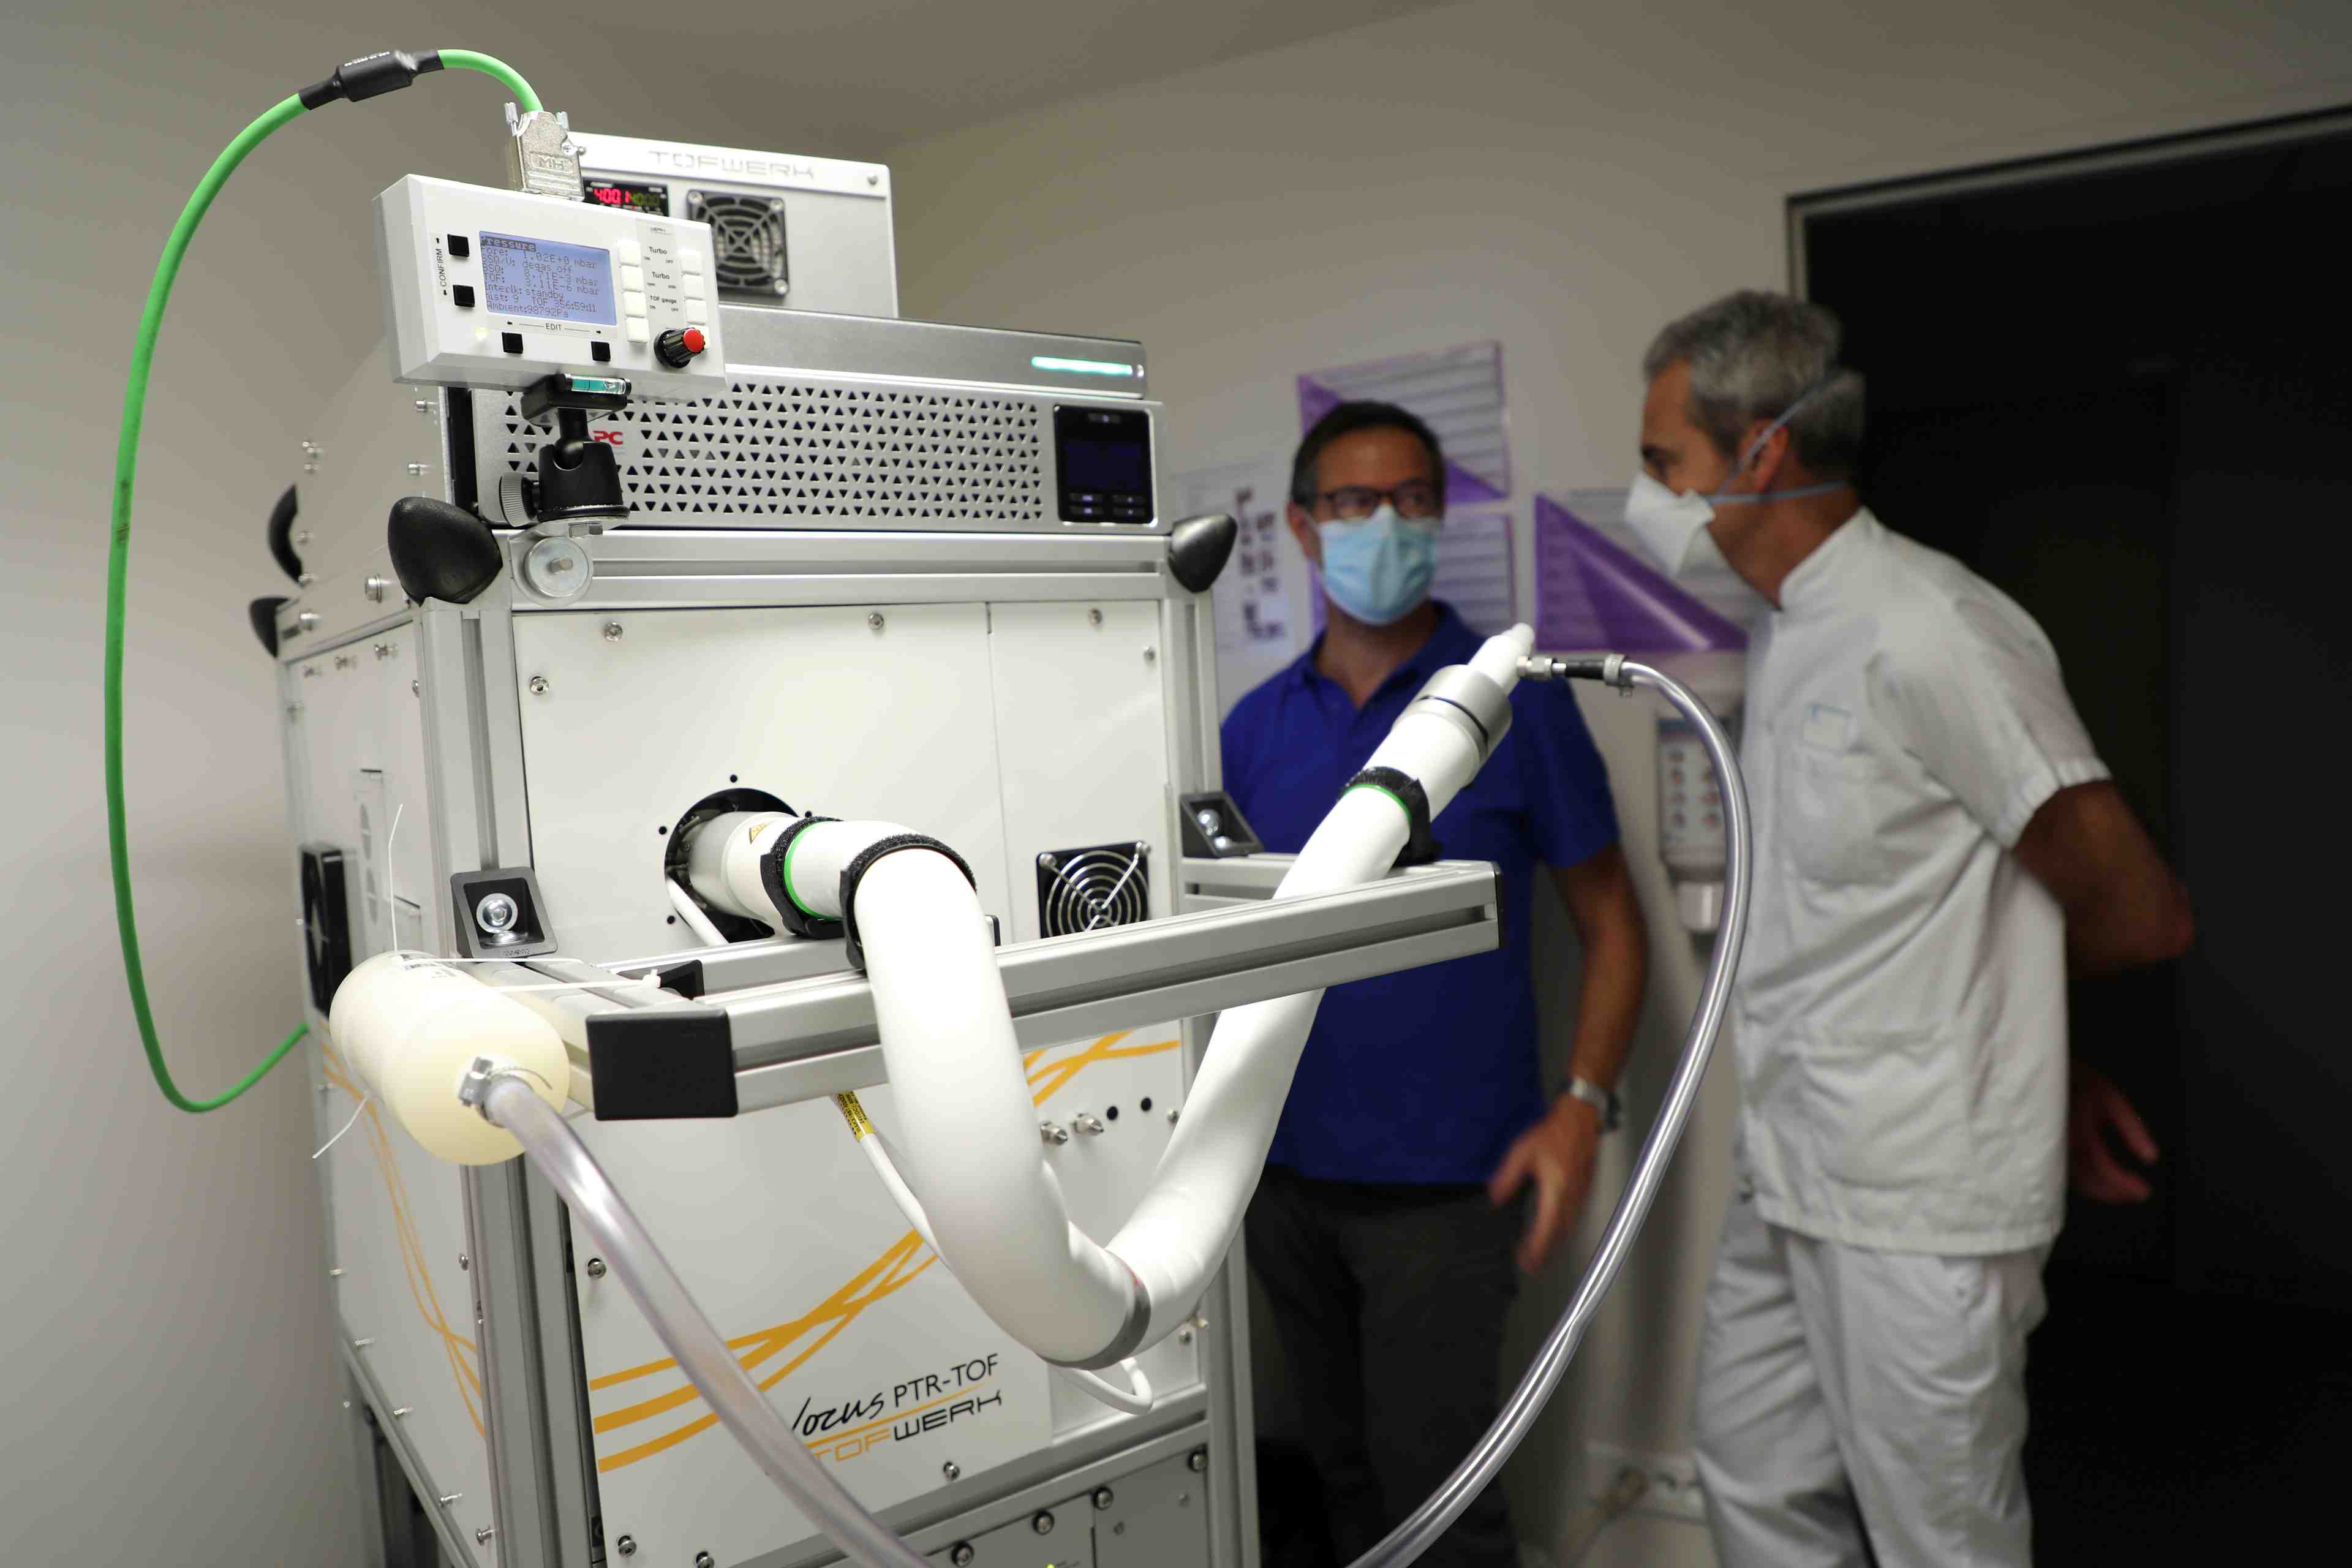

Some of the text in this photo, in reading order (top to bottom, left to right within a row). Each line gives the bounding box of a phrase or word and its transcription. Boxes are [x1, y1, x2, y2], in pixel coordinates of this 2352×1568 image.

[648, 151, 814, 179] TOFWERK
[649, 246, 667, 255] Turbo
[435, 248, 447, 287] CONFIRM
[546, 323, 563, 331] EDIT
[894, 1353, 998, 1408] PTR-TOF
